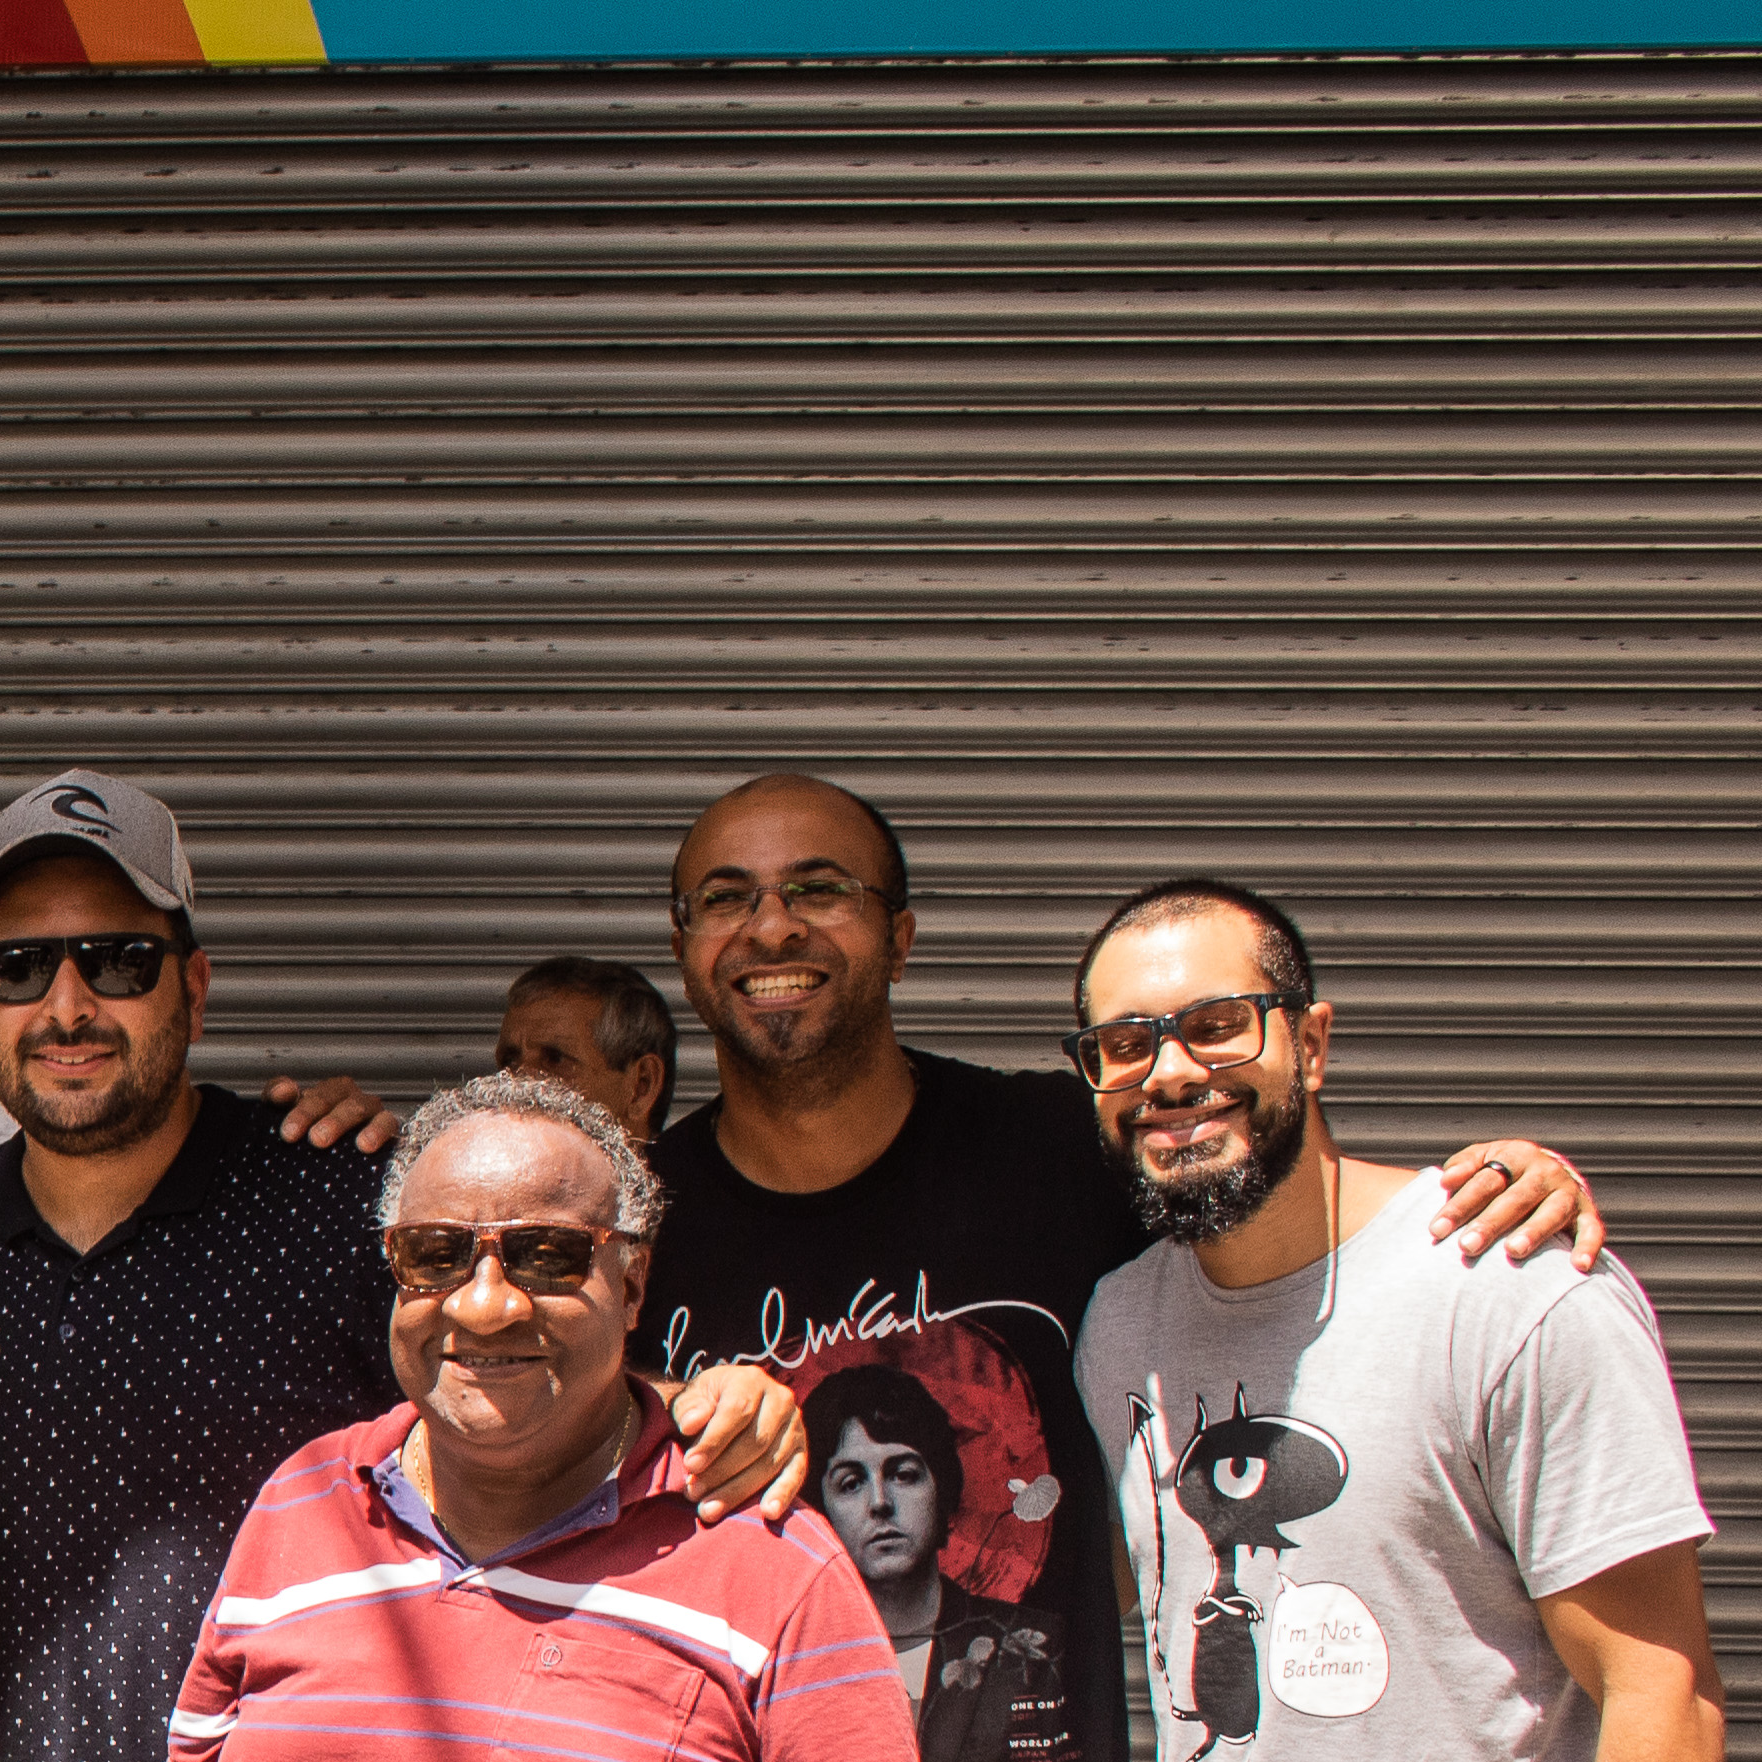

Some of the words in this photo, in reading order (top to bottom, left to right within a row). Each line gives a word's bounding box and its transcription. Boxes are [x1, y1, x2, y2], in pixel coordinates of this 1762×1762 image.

[1320, 1619, 1363, 1641] Not
[1314, 1645, 1325, 1658] a
[1008, 1739, 1052, 1749] WORLD
